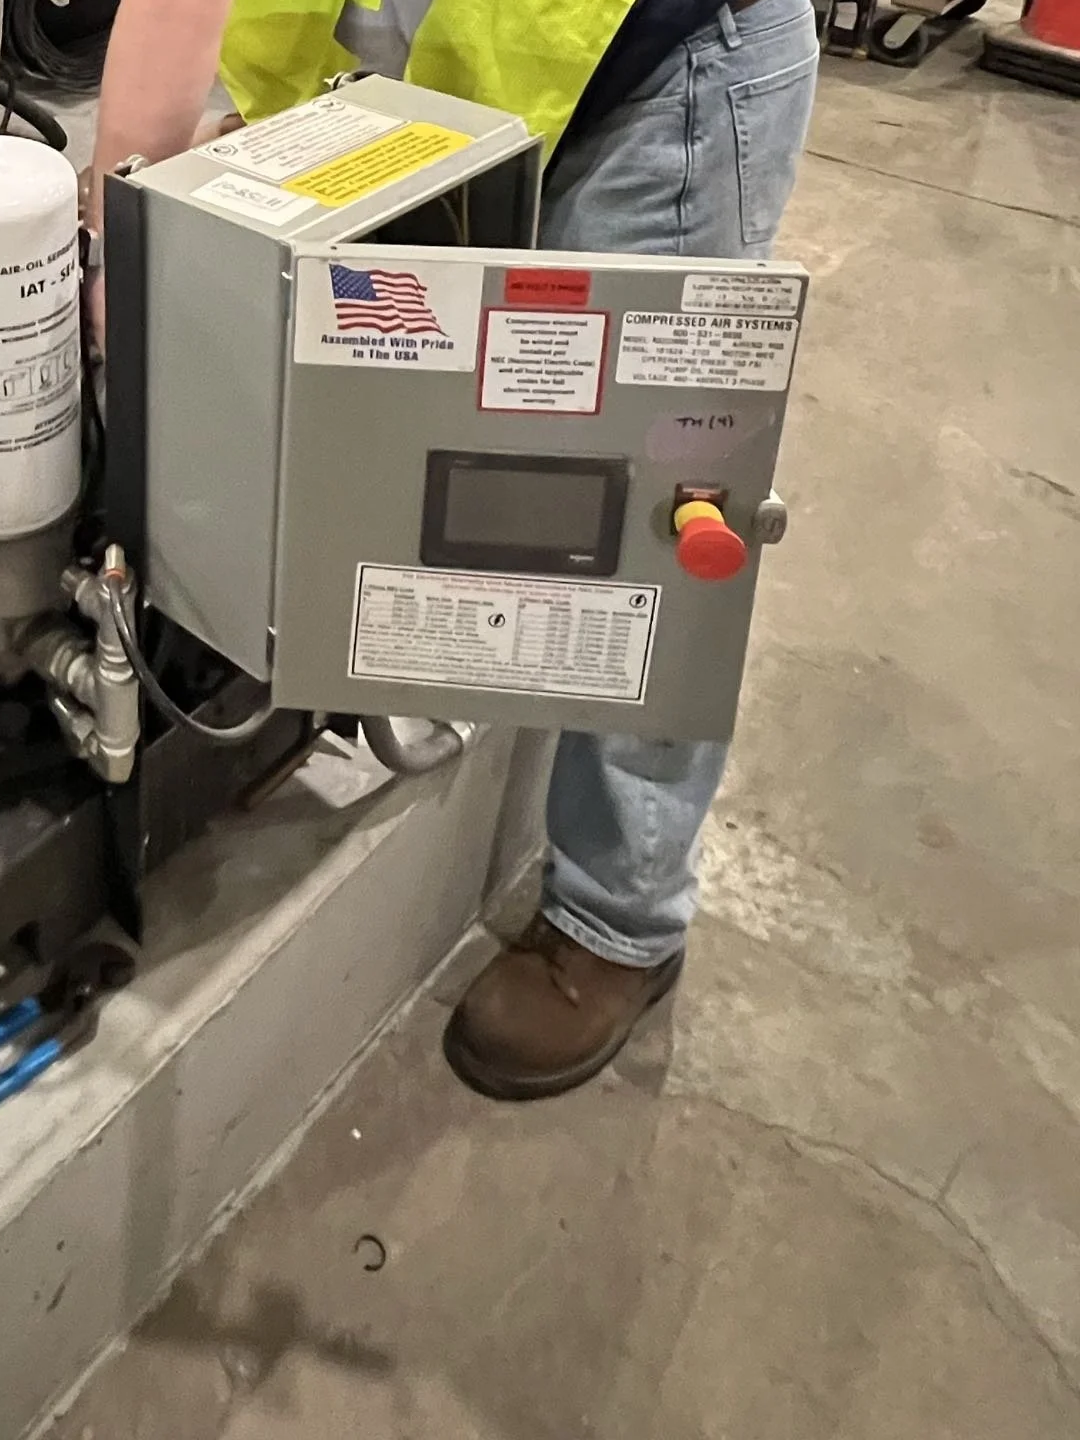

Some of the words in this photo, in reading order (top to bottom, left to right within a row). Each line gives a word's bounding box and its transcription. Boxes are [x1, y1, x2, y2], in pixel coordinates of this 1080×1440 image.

[0, 259, 44, 276] AIR-OIL
[20, 278, 46, 299] IAT
[625, 314, 707, 328] COMPRESSED
[710, 318, 732, 329] AIR
[735, 319, 793, 331] SYSTEMS
[321, 333, 386, 347] Assembled
[390, 337, 418, 348] With
[421, 338, 454, 350] Pride
[352, 349, 364, 359] In
[369, 350, 390, 360] The
[394, 351, 420, 361] USA
